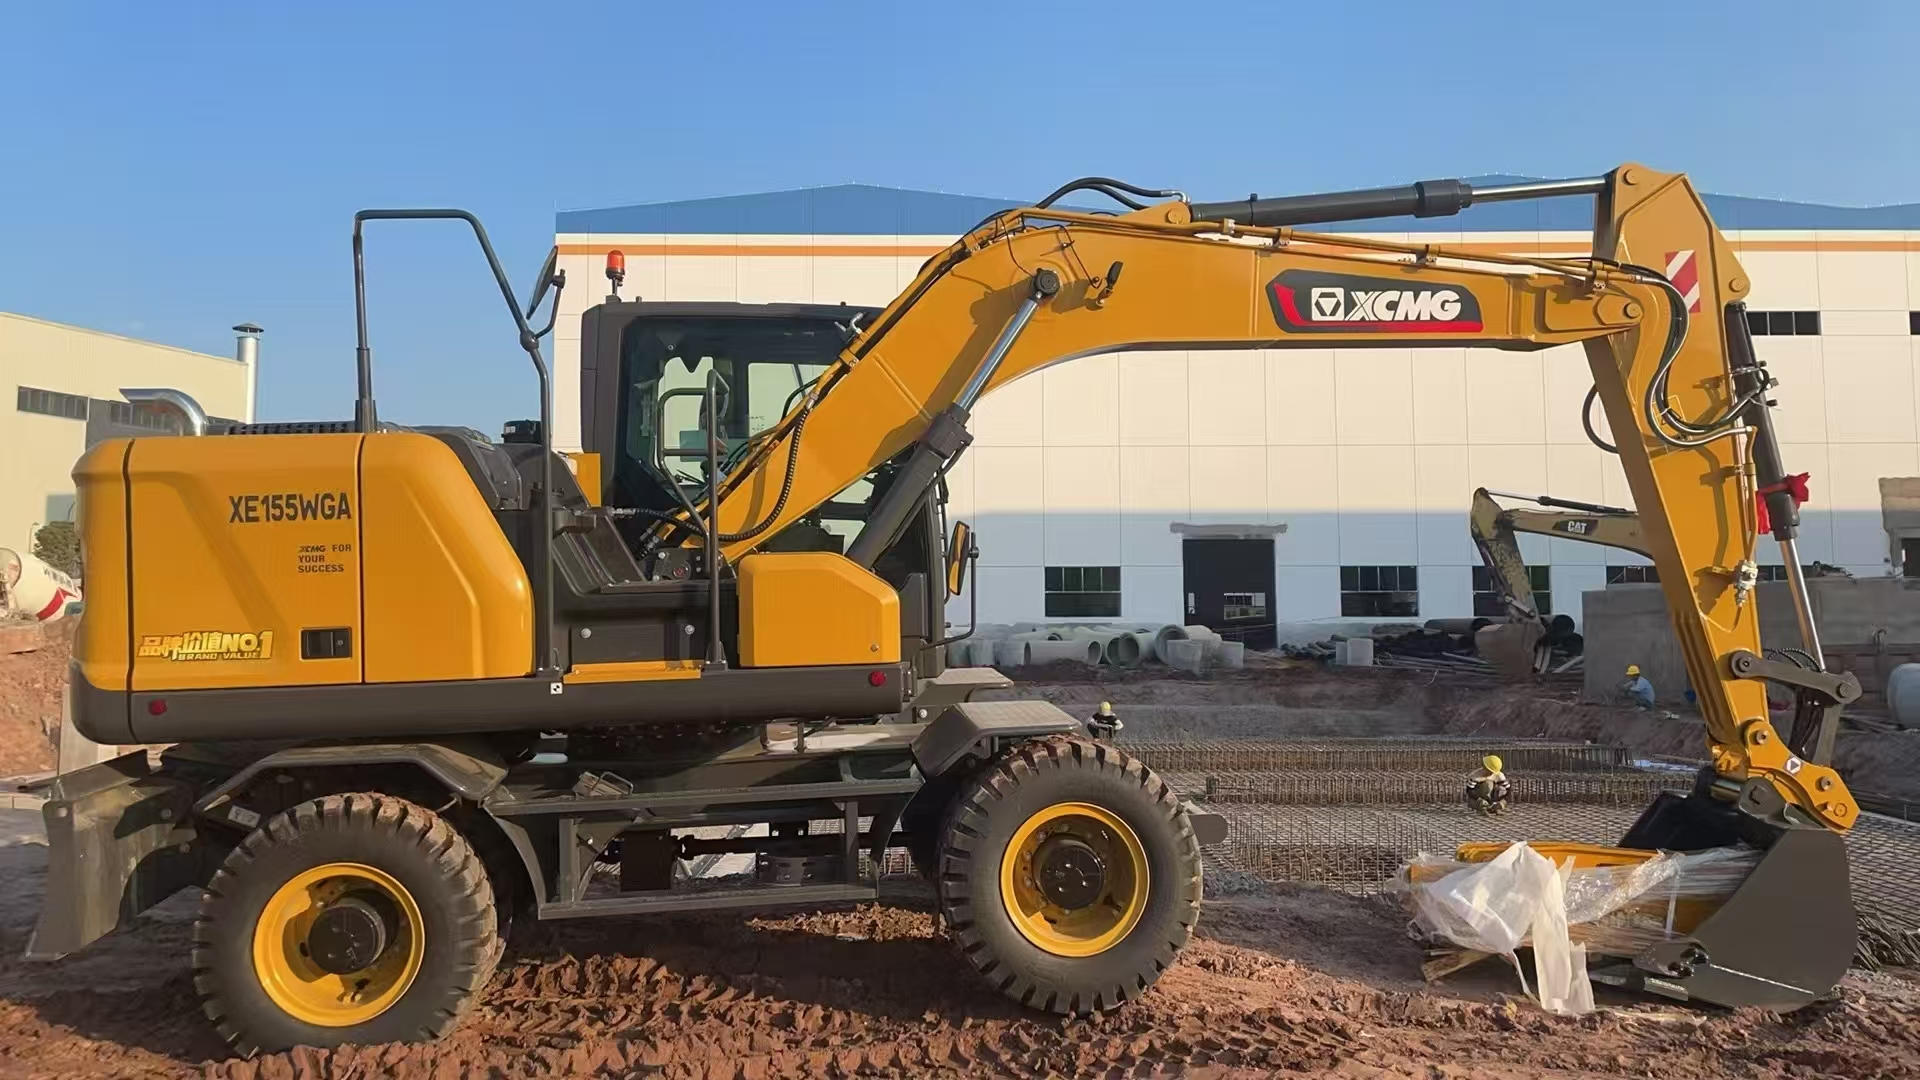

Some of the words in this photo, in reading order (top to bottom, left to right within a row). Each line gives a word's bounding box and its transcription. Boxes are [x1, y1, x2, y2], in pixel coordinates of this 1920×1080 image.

[1345, 290, 1461, 321] XCMG
[229, 492, 352, 523] XE155WGA
[1567, 520, 1587, 534] CAT
[298, 544, 327, 553] XCMG
[332, 544, 352, 552] FOR
[298, 555, 325, 563] YOUR
[298, 564, 344, 573] SUCCESS
[178, 653, 217, 661] BRAND
[223, 651, 259, 660] VALUE
